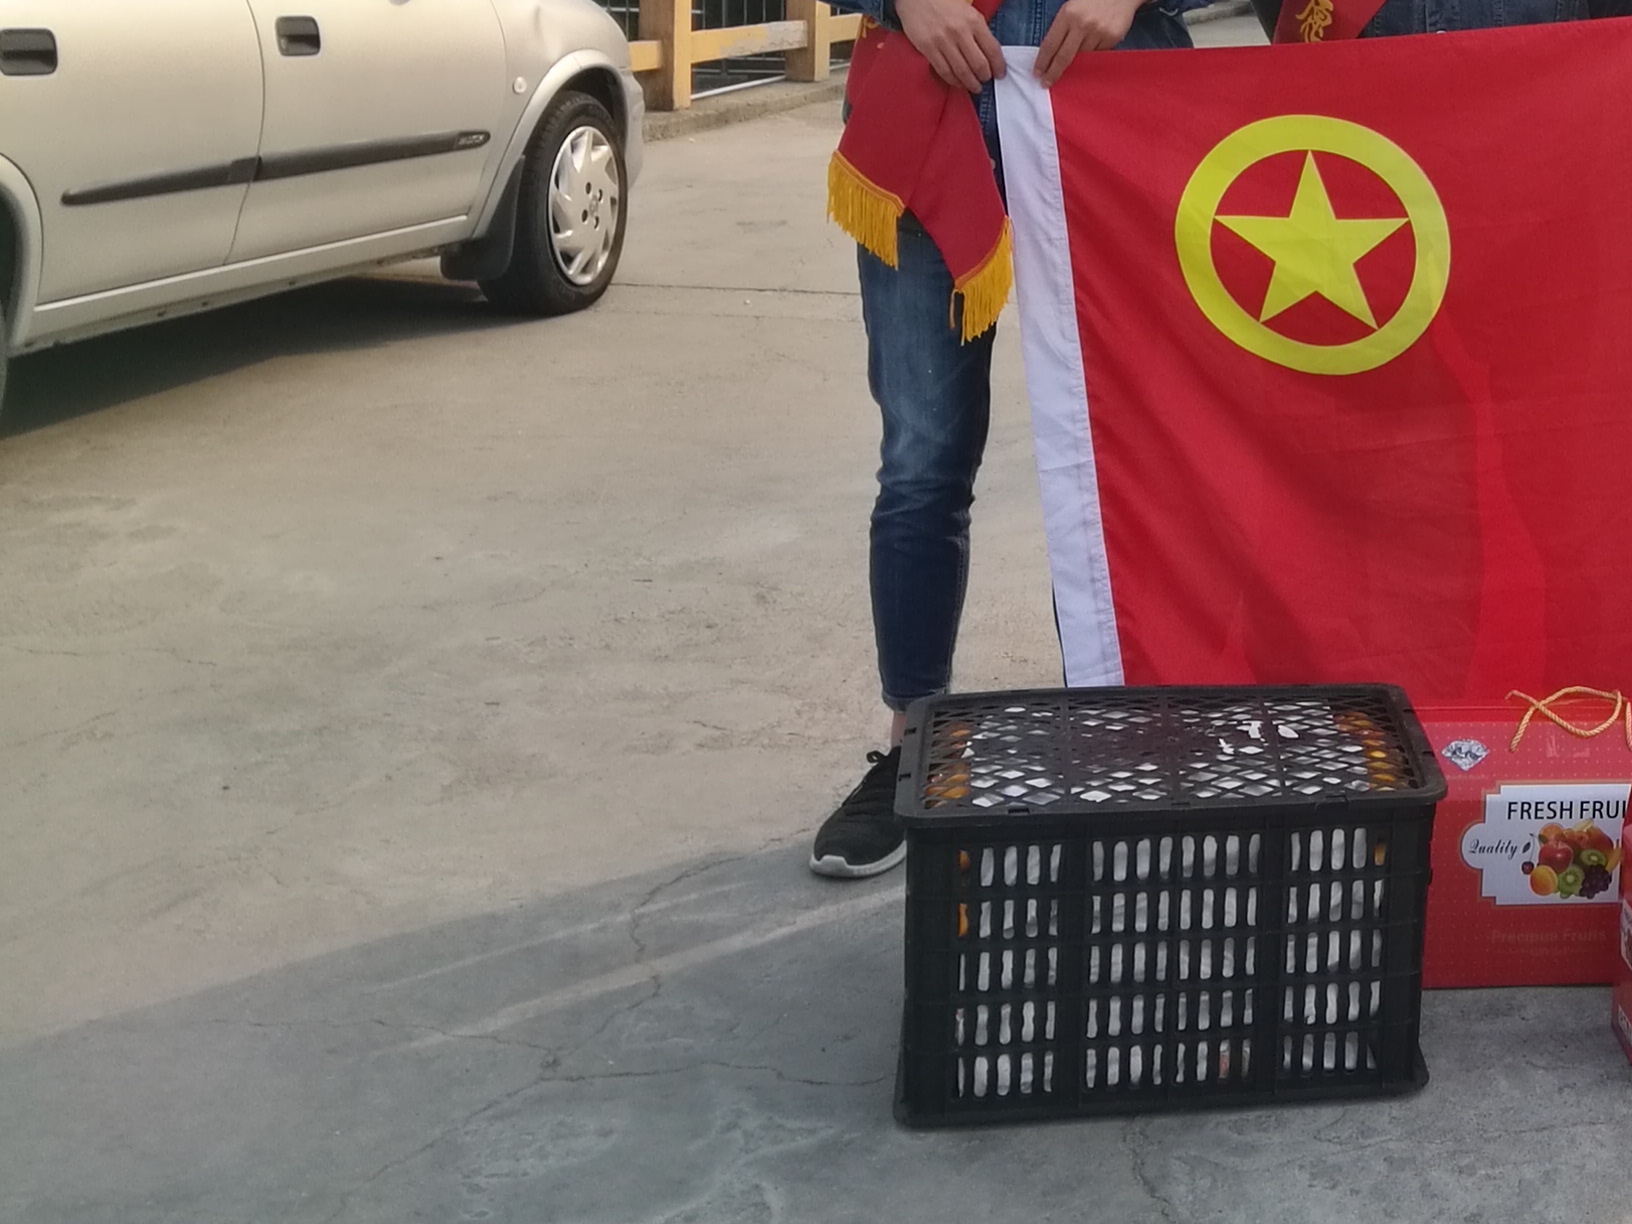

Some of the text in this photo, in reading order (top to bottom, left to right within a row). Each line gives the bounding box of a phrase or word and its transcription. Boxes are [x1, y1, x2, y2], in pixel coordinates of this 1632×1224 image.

[1507, 800, 1627, 820] FRESH FRUI
[1468, 838, 1518, 860] Quality
